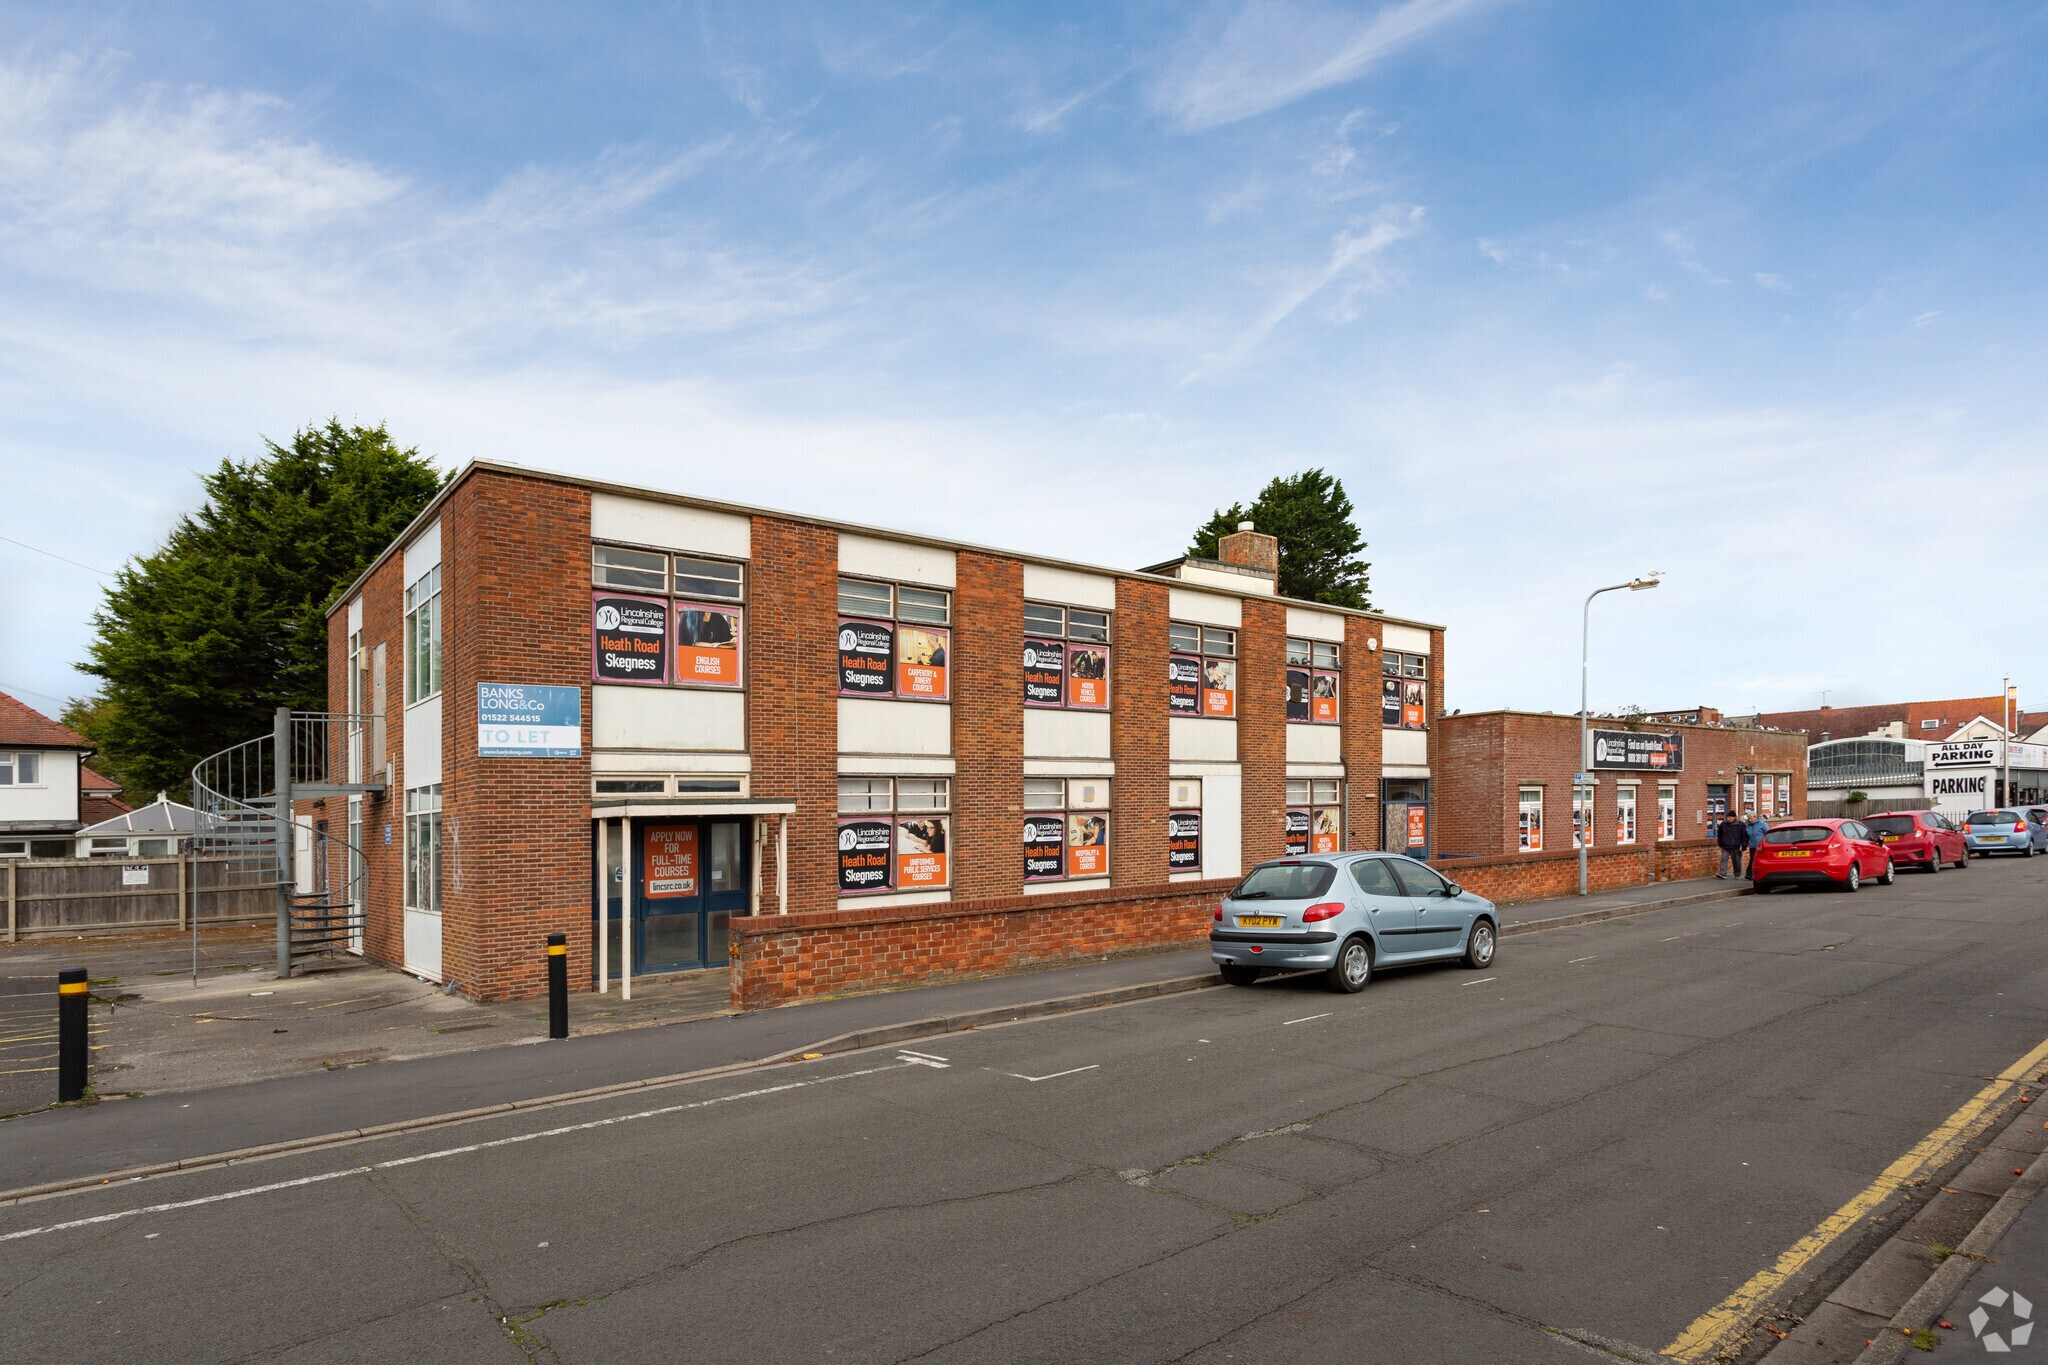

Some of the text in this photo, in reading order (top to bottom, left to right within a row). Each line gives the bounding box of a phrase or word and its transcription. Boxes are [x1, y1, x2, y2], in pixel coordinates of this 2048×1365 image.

[621, 607, 664, 620] Lincolnshire
[621, 616, 664, 628] Regional College
[858, 631, 890, 641] Lincolnshire
[601, 636, 660, 653] Heath Road
[875, 640, 890, 648] College
[1037, 650, 1062, 658] Lincolnshire
[606, 654, 656, 672] Skegness
[696, 656, 720, 665] ENGLISH
[842, 656, 886, 670] Heath Road
[695, 666, 720, 674] COURSES
[908, 668, 932, 676] CARPENTRY
[846, 670, 883, 686] Skegness
[1025, 671, 1059, 684] Heath Road
[482, 688, 523, 699] BANKS
[913, 684, 932, 692] COURSES
[1028, 685, 1057, 698] Skegness
[1184, 685, 1196, 695] Road
[482, 699, 544, 710] LONG&Co
[1171, 695, 1194, 708] Skegness
[510, 714, 540, 722] 544515
[483, 730, 550, 743] TO LET
[1645, 741, 1654, 750] Heath
[1932, 750, 1993, 761] PARKING
[1933, 777, 1984, 794] PARKING
[651, 831, 692, 842] APPLY NOW
[857, 828, 889, 836] Lincolnshire
[857, 835, 874, 843] Regional
[1184, 840, 1196, 849] Road
[665, 843, 679, 853] FOR
[1025, 845, 1059, 857] Heath Road
[652, 854, 692, 865] FULL-TIME
[842, 853, 886, 867] Heath Road
[1171, 852, 1194, 863] Skegness
[1028, 859, 1057, 872] Skegness
[655, 866, 689, 877] COURSES
[846, 870, 883, 884] Skegness
[653, 881, 691, 891] lincsrc.co.uk
